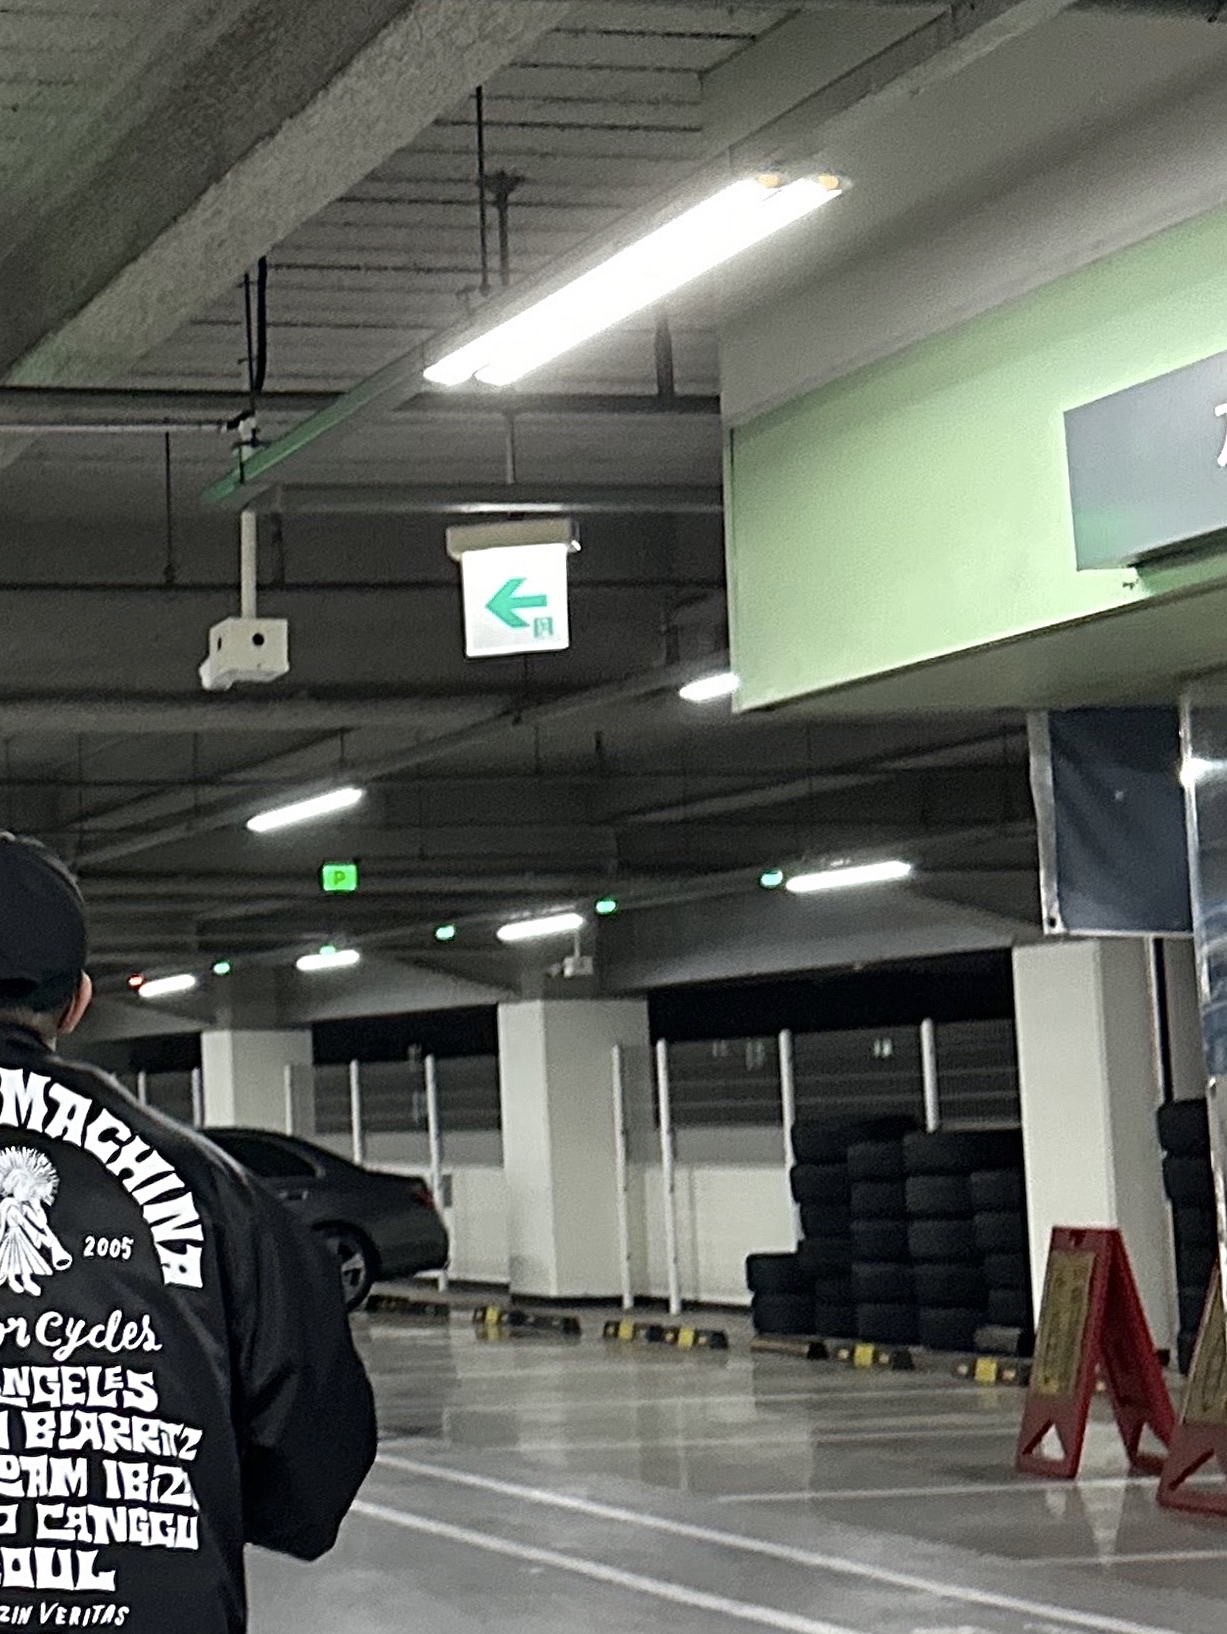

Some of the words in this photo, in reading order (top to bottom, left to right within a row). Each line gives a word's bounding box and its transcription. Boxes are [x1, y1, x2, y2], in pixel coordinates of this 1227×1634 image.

[83, 1236, 134, 1260] 2005
[35, 1502, 199, 1551] CANGGU
[39, 1602, 130, 1627] VERITAS
